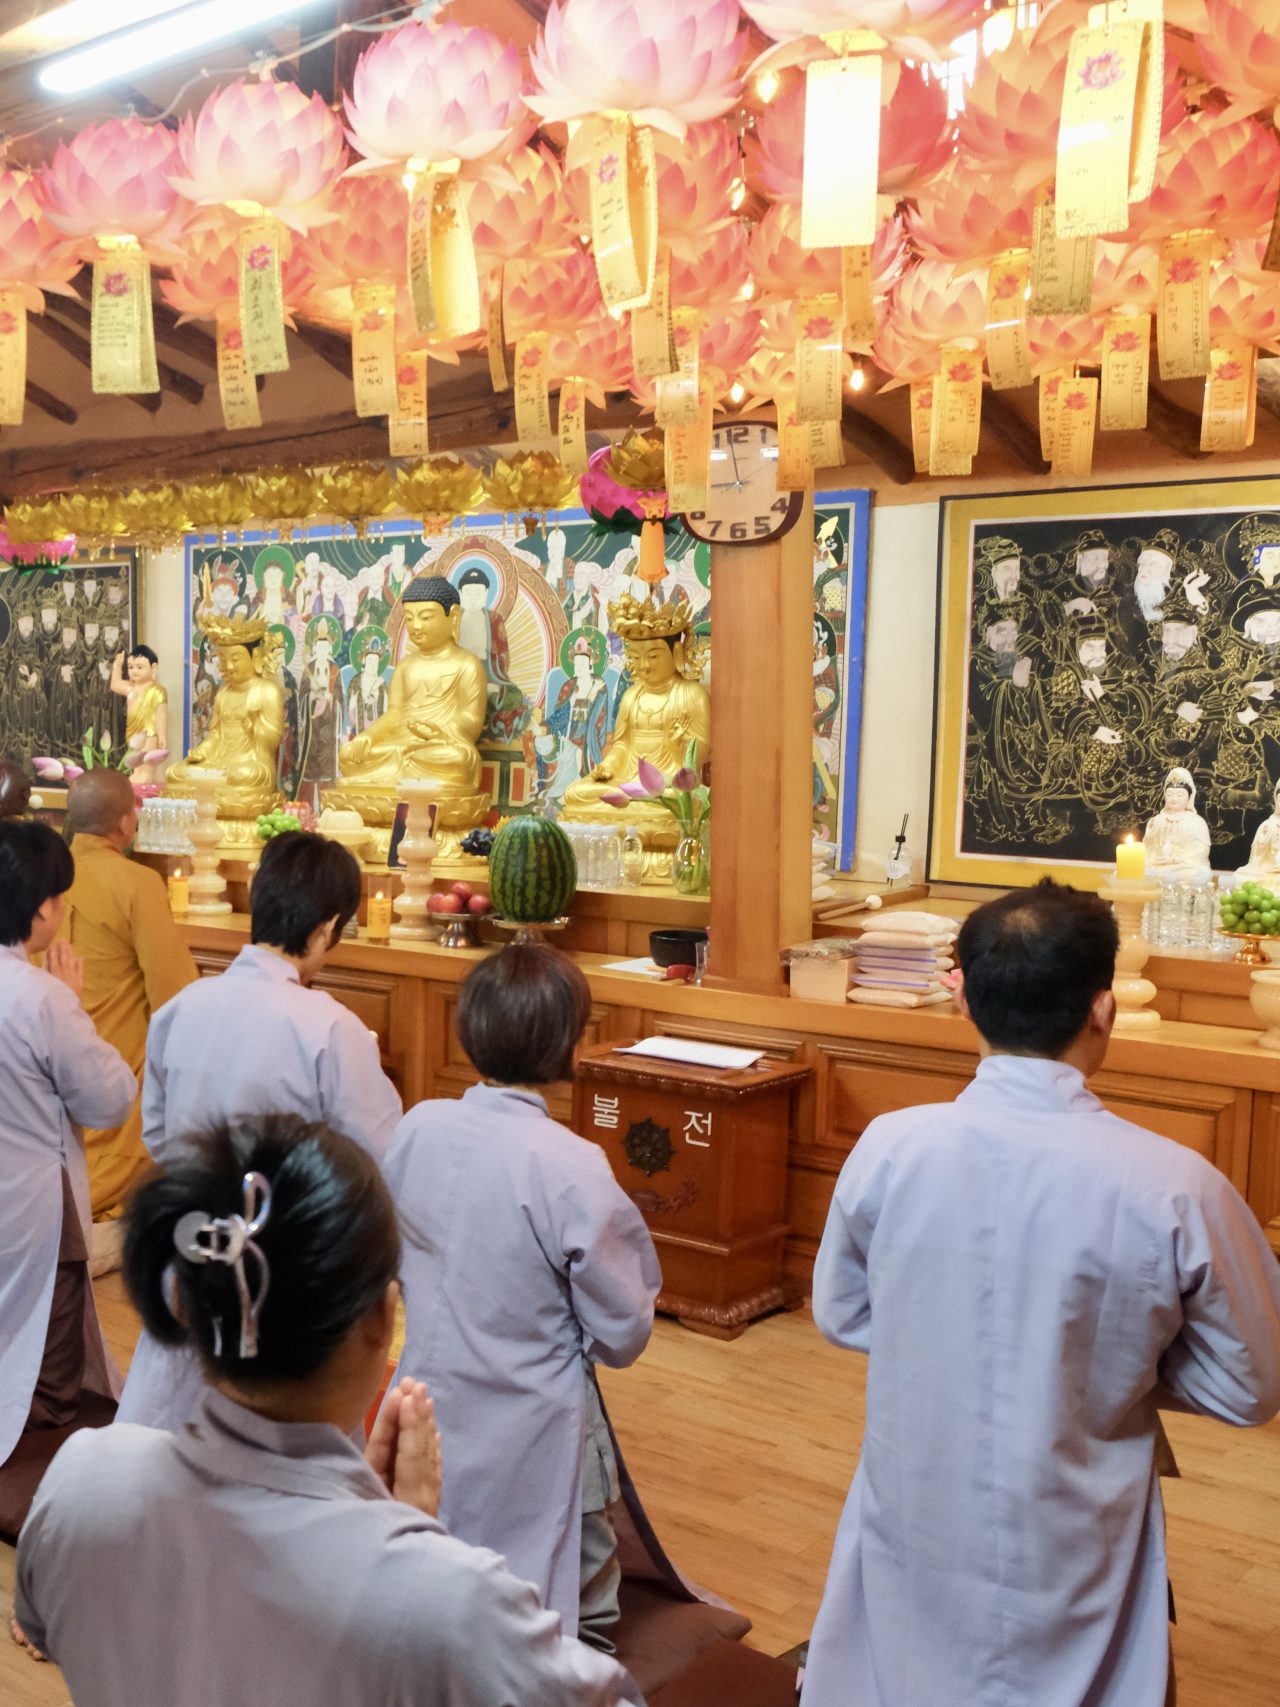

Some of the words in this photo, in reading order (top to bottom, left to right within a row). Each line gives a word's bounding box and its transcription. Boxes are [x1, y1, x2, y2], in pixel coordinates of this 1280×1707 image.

[713, 432, 721, 448] 1
[726, 427, 749, 444] 12
[759, 427, 768, 444] 1
[770, 497, 789, 515] 4
[706, 520, 723, 537] 7
[729, 522, 747, 539] 6
[754, 516, 771, 535] 5
